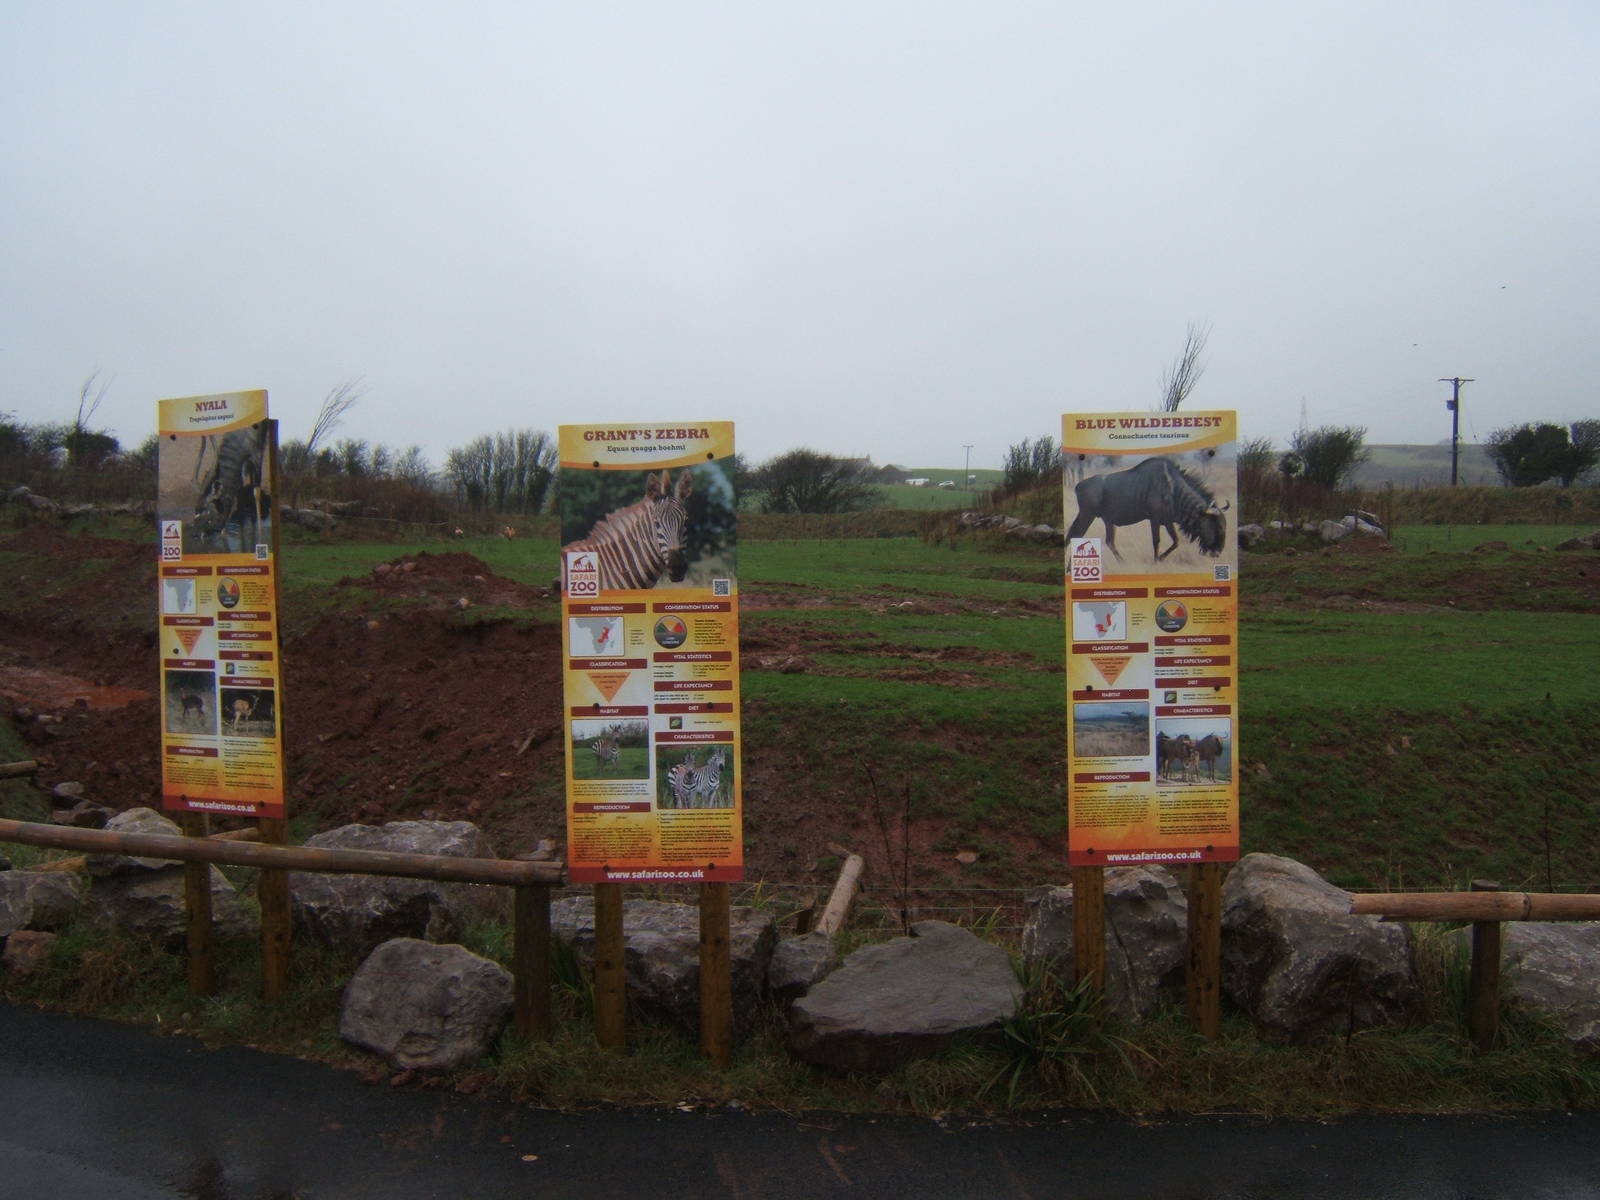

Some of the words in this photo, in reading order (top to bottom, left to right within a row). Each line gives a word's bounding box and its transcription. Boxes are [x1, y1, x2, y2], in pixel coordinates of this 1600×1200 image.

[195, 399, 227, 412] NYALA
[1075, 418, 1116, 430] BLUE
[1118, 416, 1222, 429] WILDEBEEST
[584, 430, 652, 441] GRANT'S
[656, 428, 710, 440] ZEBRA
[1109, 432, 1158, 440] Connochaetes
[607, 445, 630, 453] Equus
[631, 445, 657, 453] quagga
[164, 547, 180, 556] ZOO
[1073, 559, 1100, 567] SAFARI
[1073, 567, 1100, 577] ZOO
[570, 582, 597, 592] ZOO
[188, 801, 256, 813] www.safarizoo.co.uk
[1107, 851, 1201, 862] www.safarizoo.co.uk
[607, 869, 704, 879] www.safarizoo.co.uk
